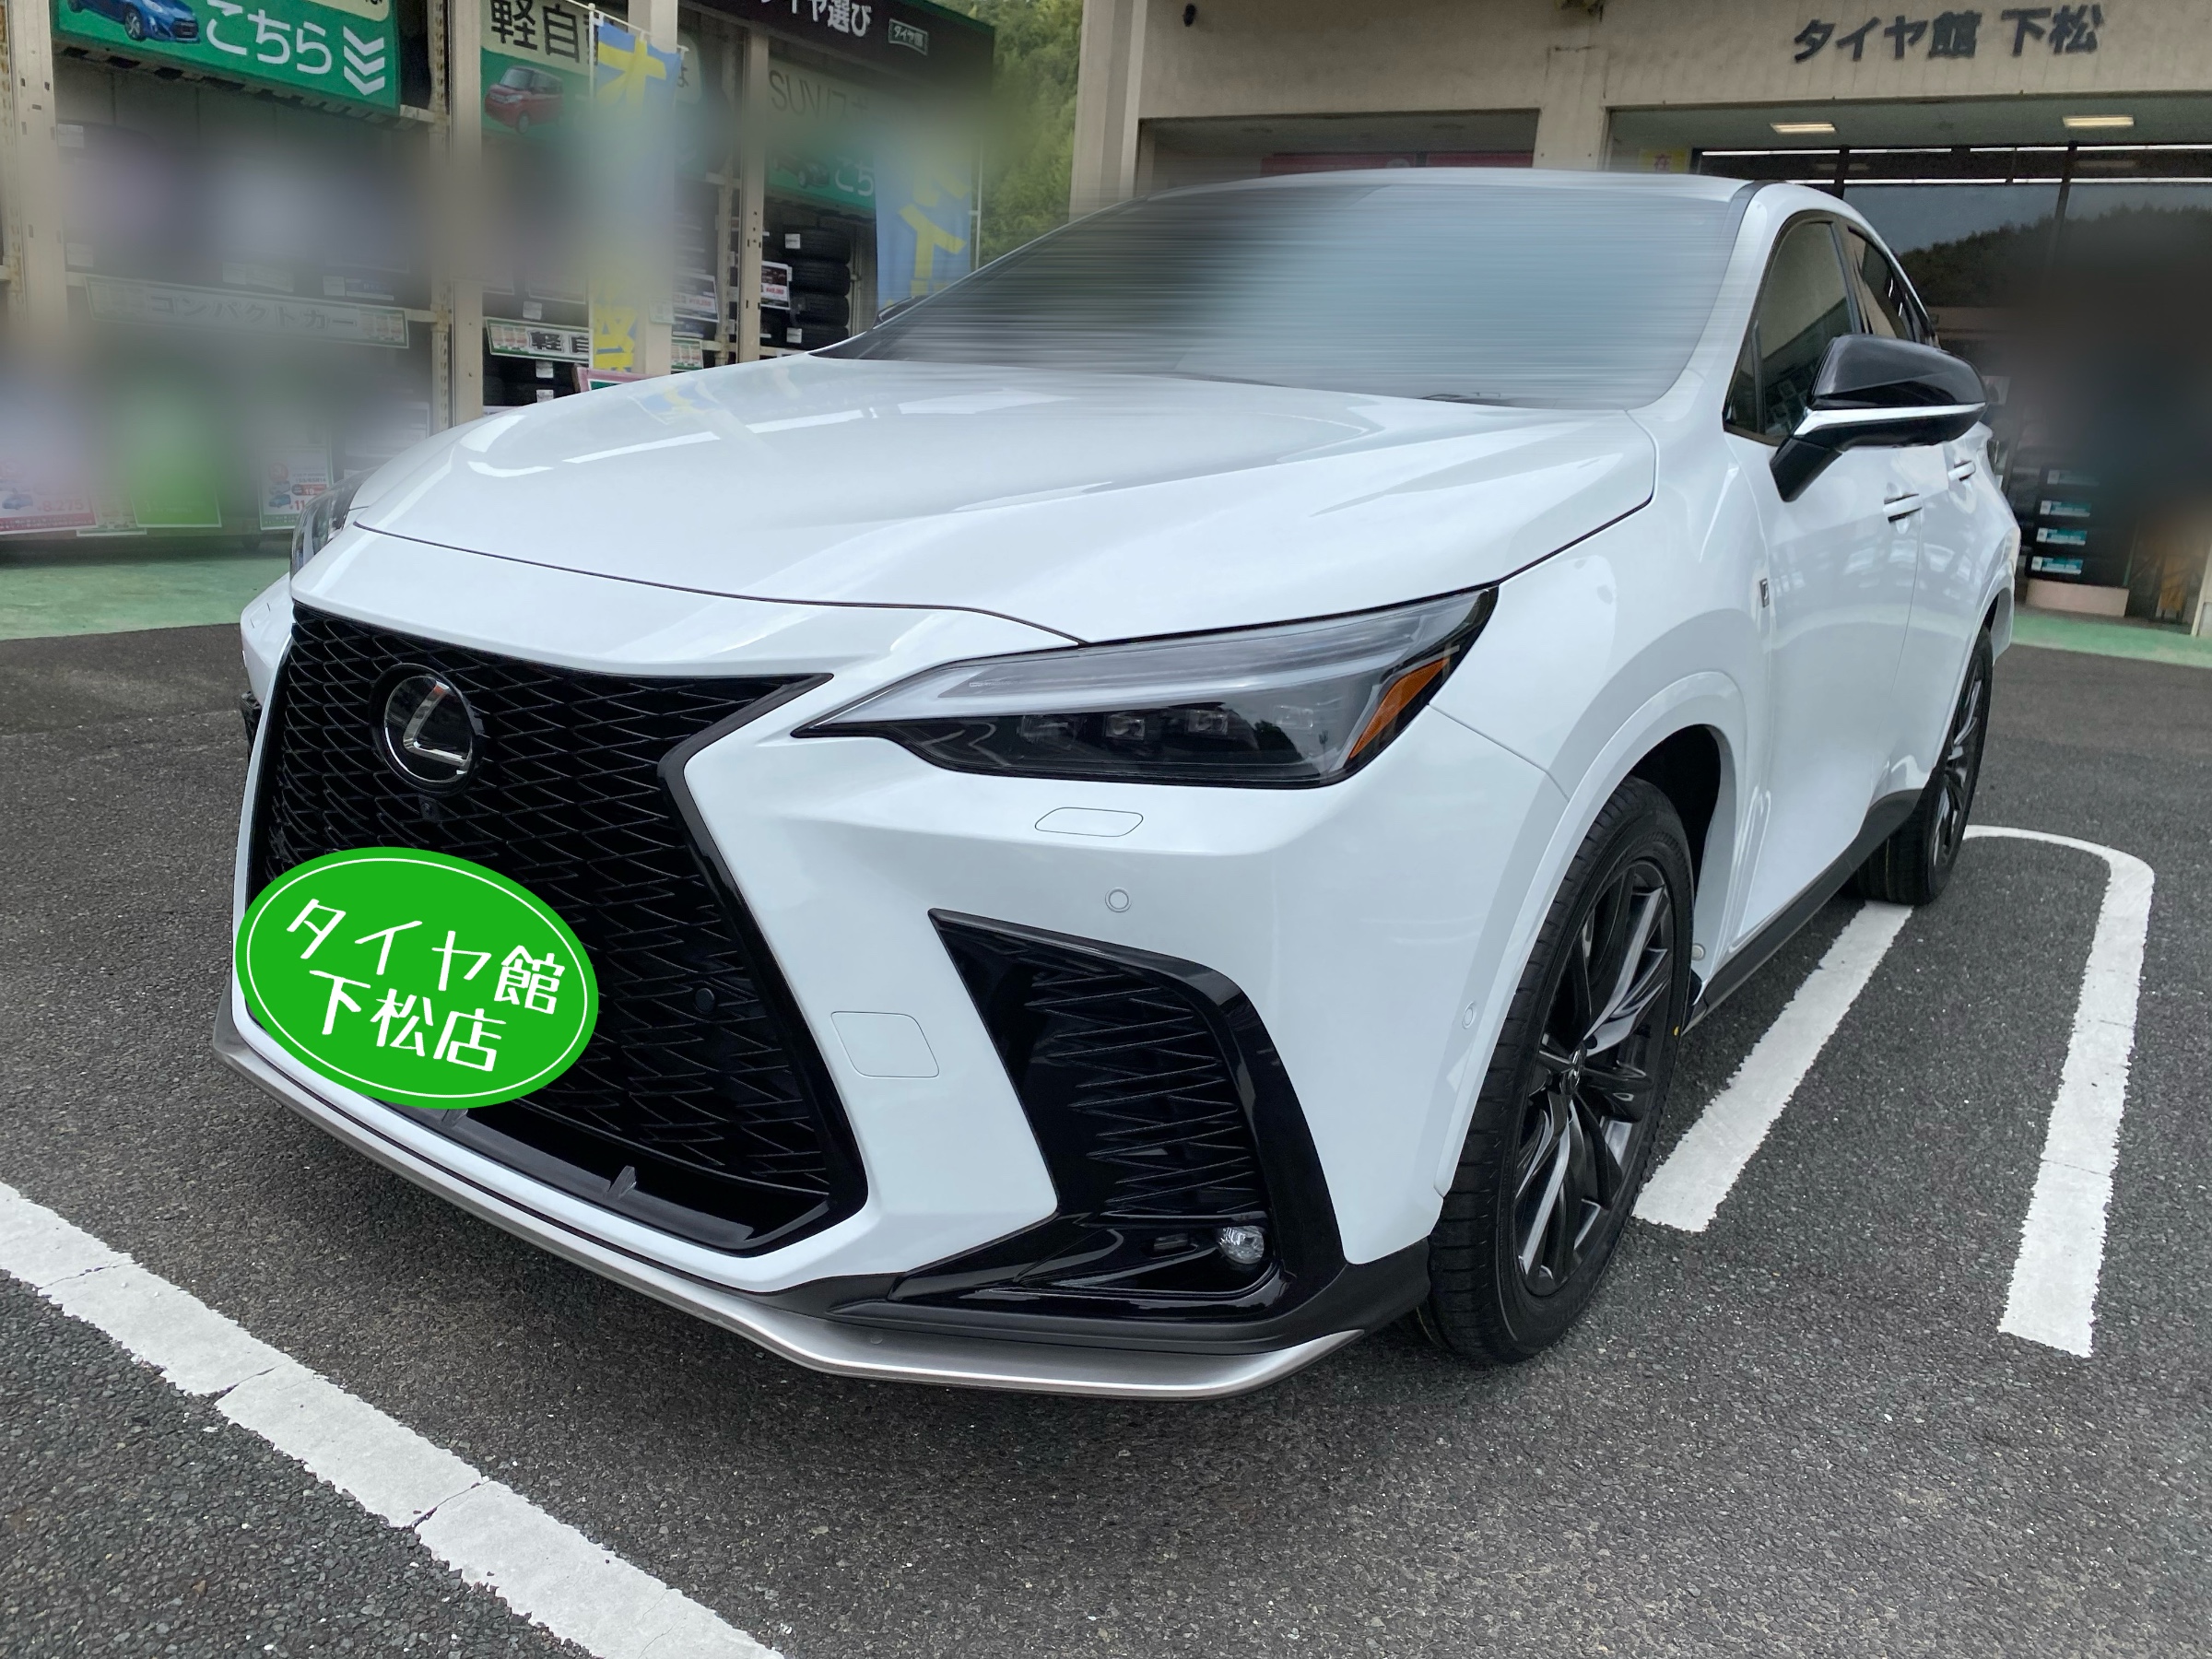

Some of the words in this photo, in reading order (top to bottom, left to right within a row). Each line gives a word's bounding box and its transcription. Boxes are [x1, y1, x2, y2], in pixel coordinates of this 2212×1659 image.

[206, 0, 332, 75] こちら
[1794, 11, 1983, 63] タイヤ館
[2001, 4, 2102, 55] 下松
[149, 295, 357, 329] コンパクトカー
